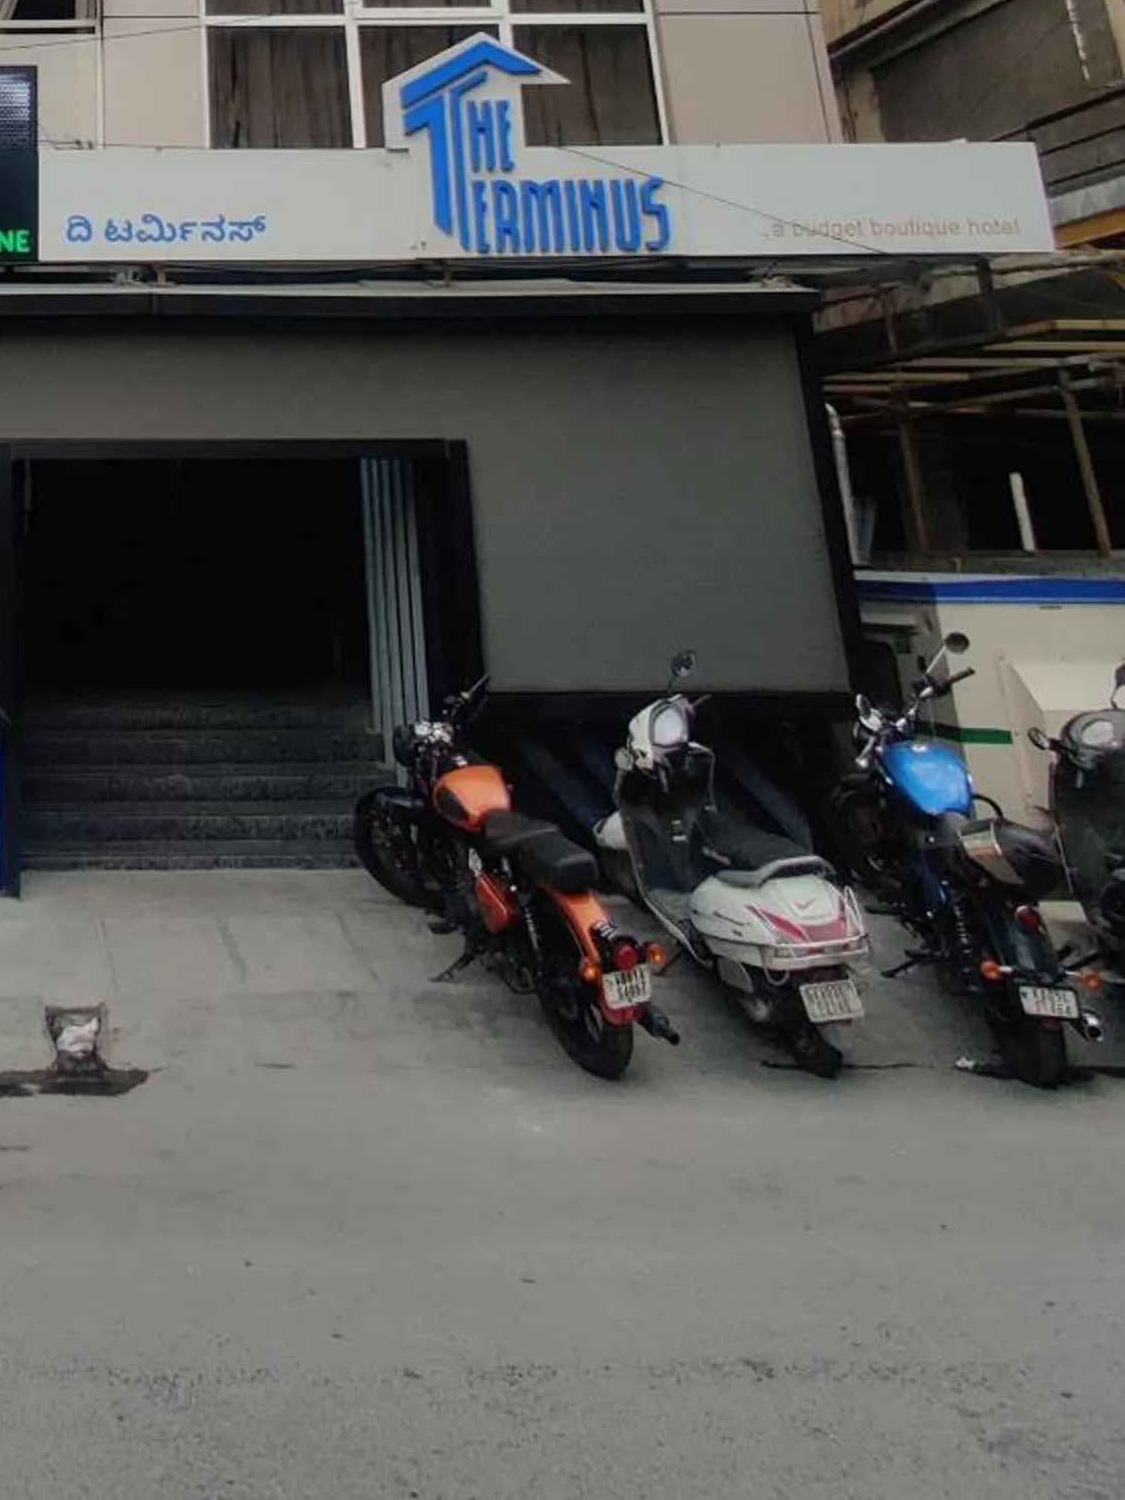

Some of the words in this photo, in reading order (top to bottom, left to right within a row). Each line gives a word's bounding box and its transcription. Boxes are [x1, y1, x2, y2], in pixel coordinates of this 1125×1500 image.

[65, 214, 93, 243] ದಿ
[771, 221, 785, 238] a
[792, 217, 863, 241] budget
[871, 216, 963, 241] boutique
[966, 216, 1021, 238] hotel
